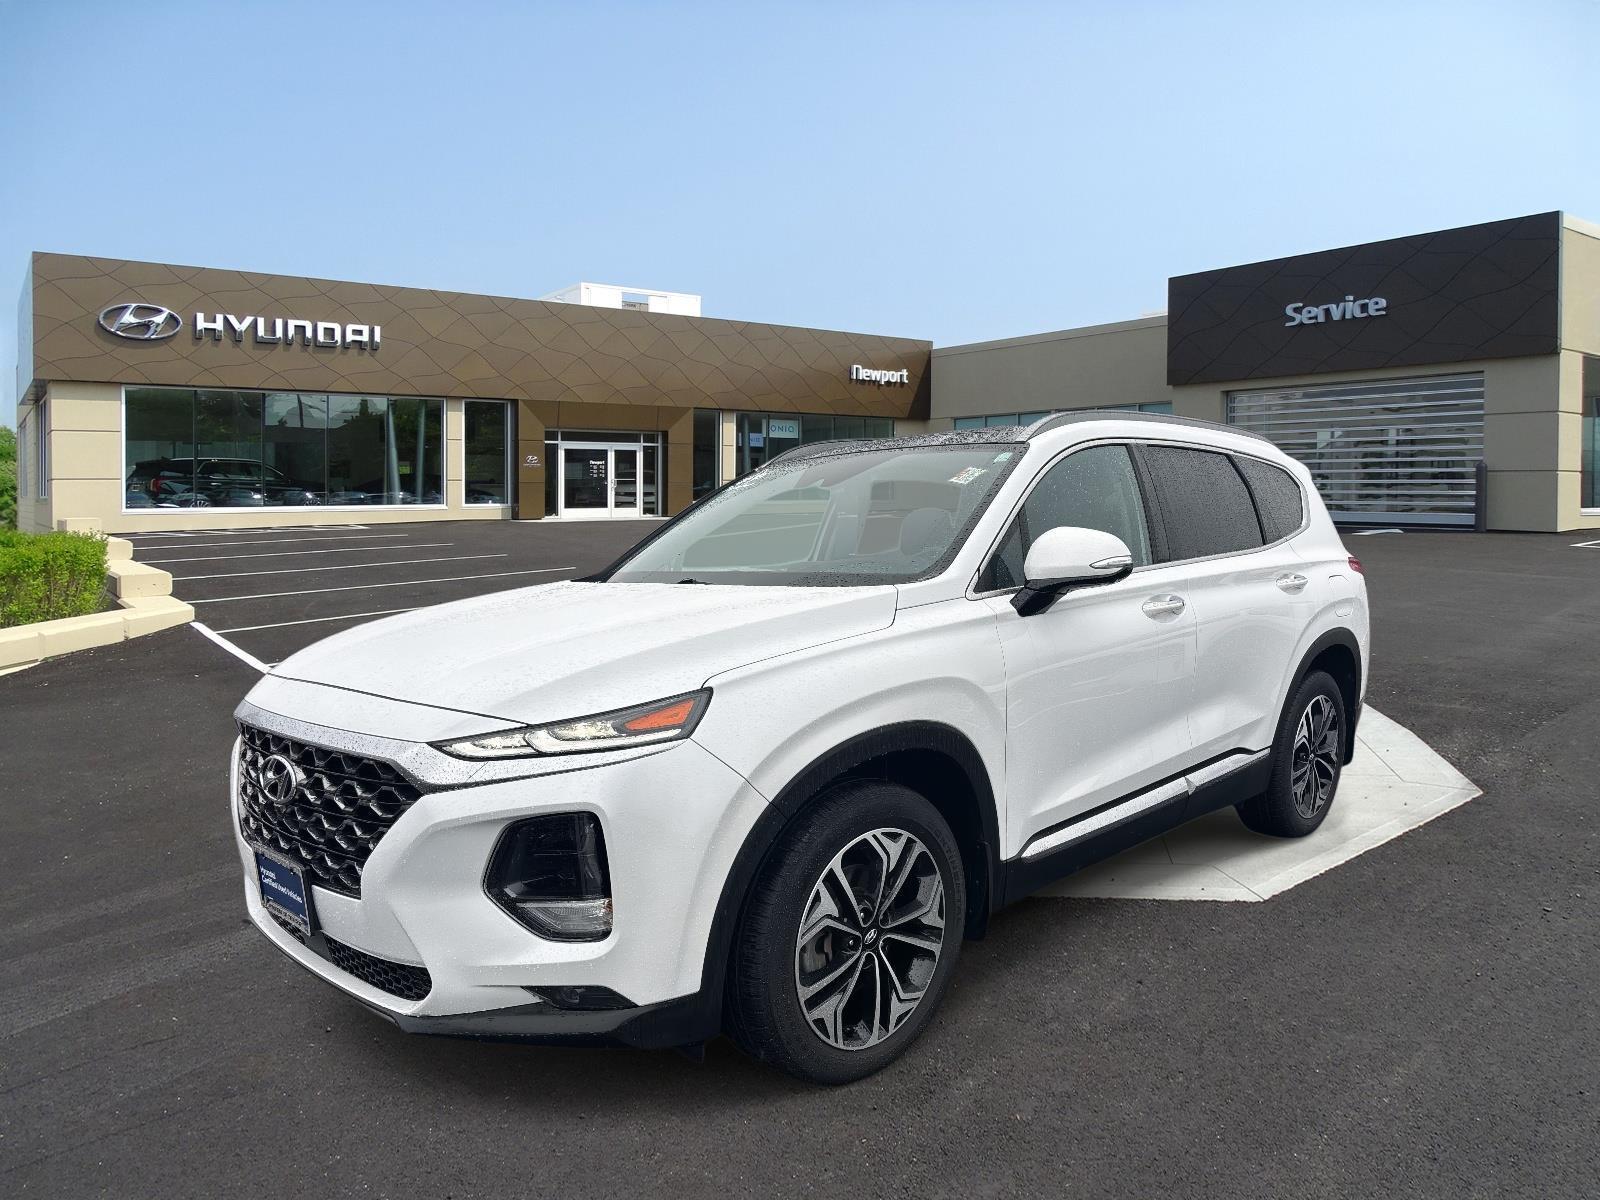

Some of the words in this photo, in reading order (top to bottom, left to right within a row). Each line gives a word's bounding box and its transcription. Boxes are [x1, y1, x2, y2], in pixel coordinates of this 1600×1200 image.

[1285, 296, 1387, 327] Service
[195, 312, 381, 350] HYUNDAI
[850, 364, 909, 385] Newport
